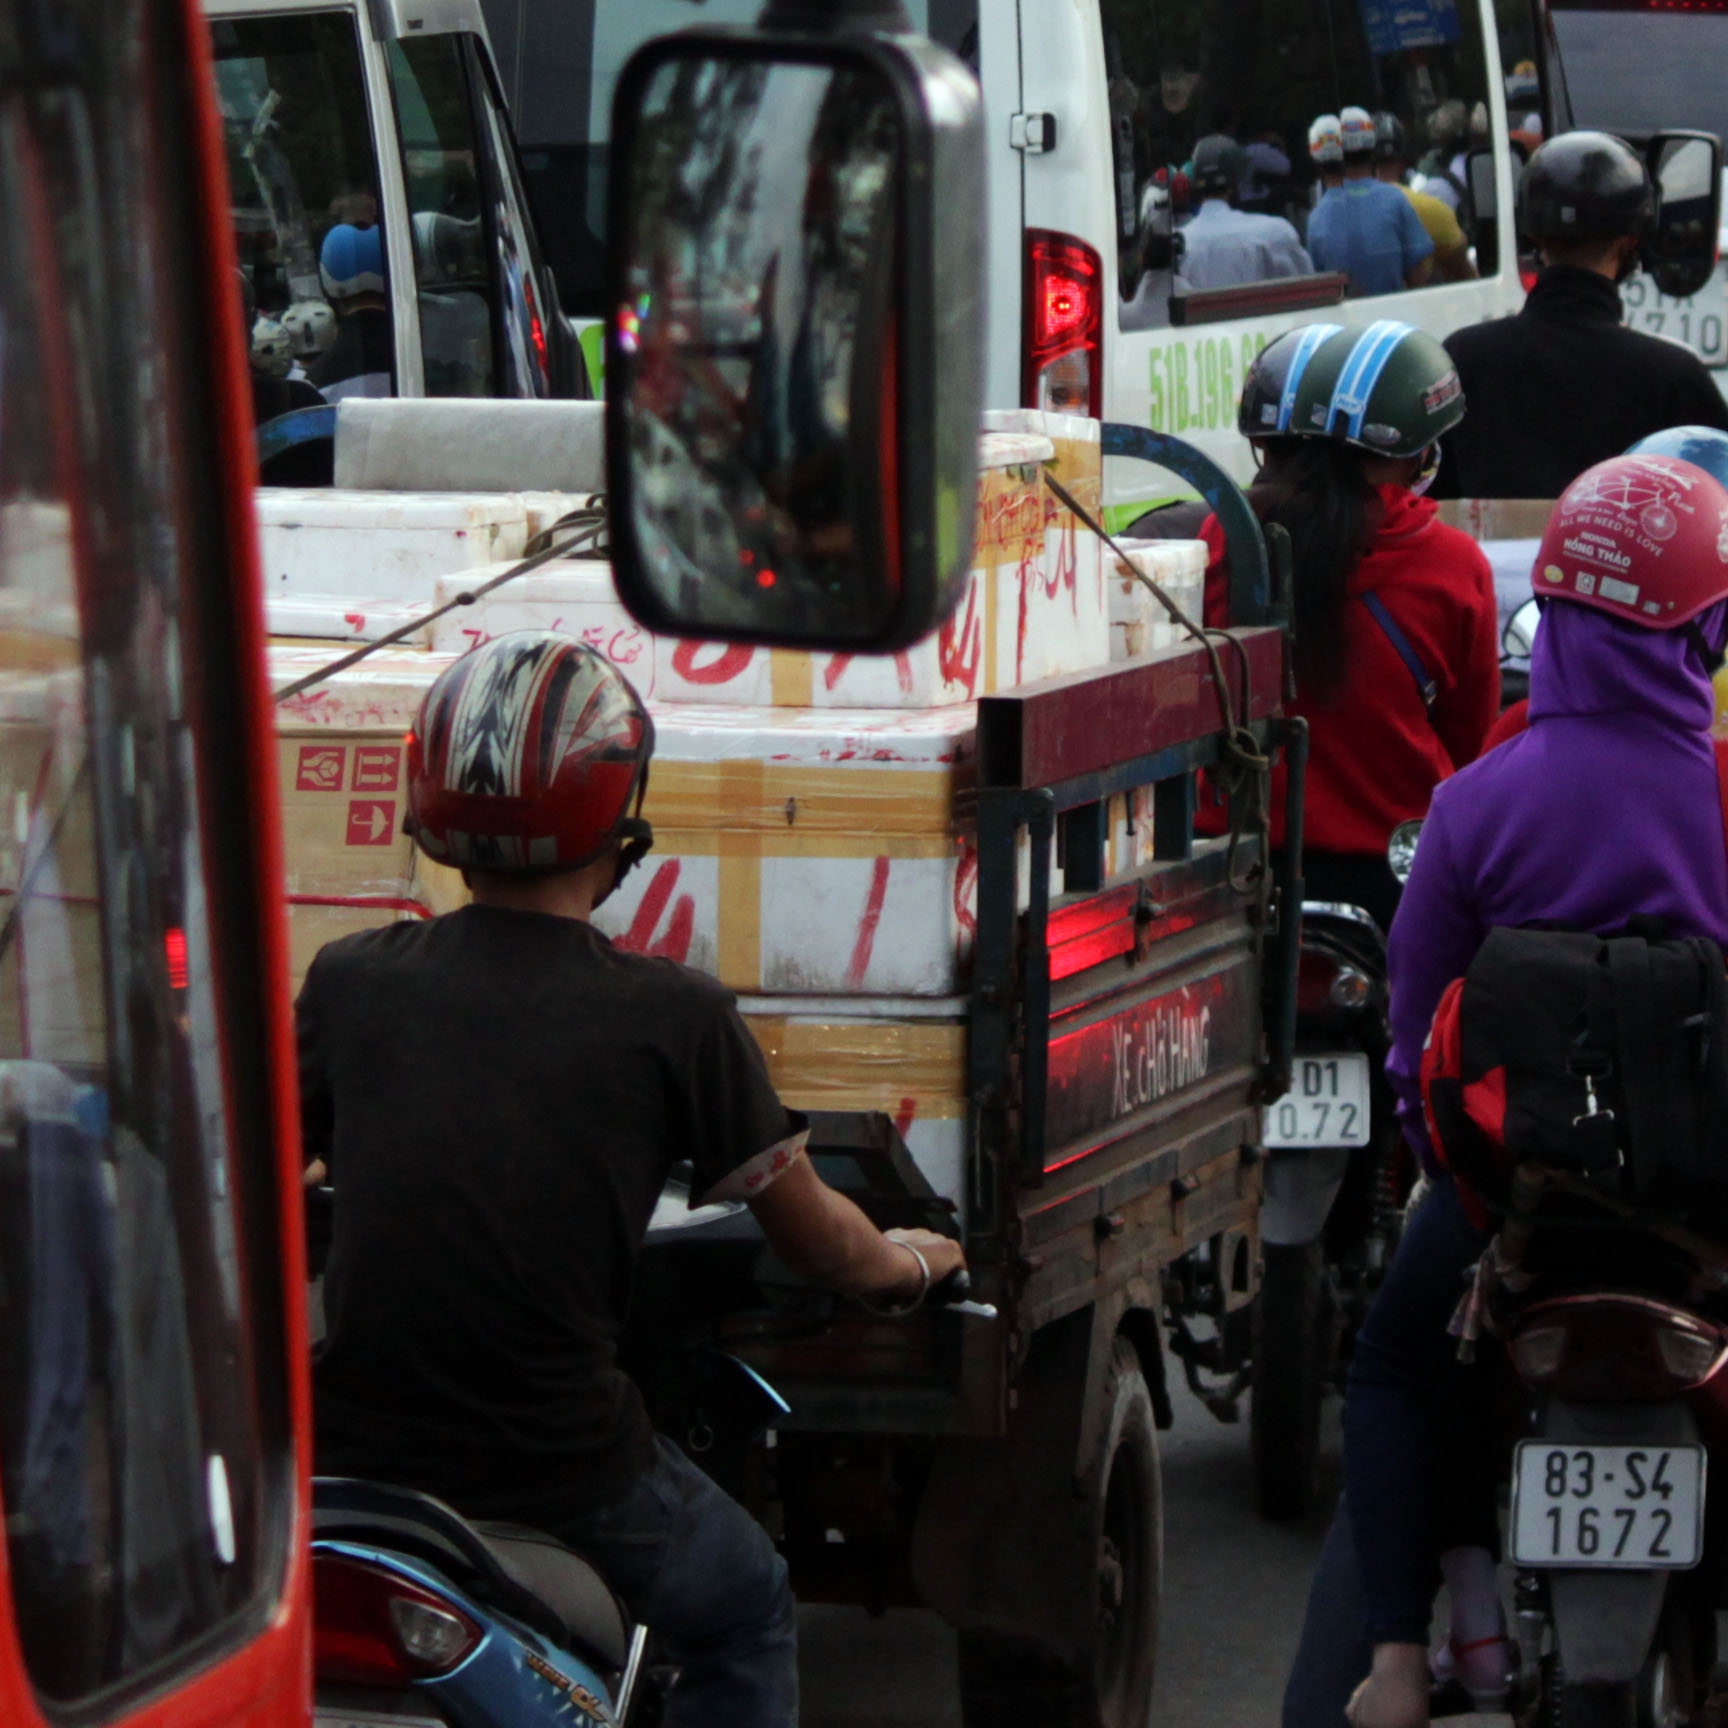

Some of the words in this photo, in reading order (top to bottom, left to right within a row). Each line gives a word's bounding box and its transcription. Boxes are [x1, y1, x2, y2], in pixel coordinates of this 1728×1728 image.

[1580, 531, 1617, 549] HONDA
[1593, 515, 1622, 532] NEED
[1624, 527, 1635, 539] IS
[1636, 535, 1665, 558] LOVE
[1264, 1103, 1359, 1140] 0.72
[1546, 1450, 1674, 1500] 83-S4
[1547, 1506, 1672, 1557] 1672
